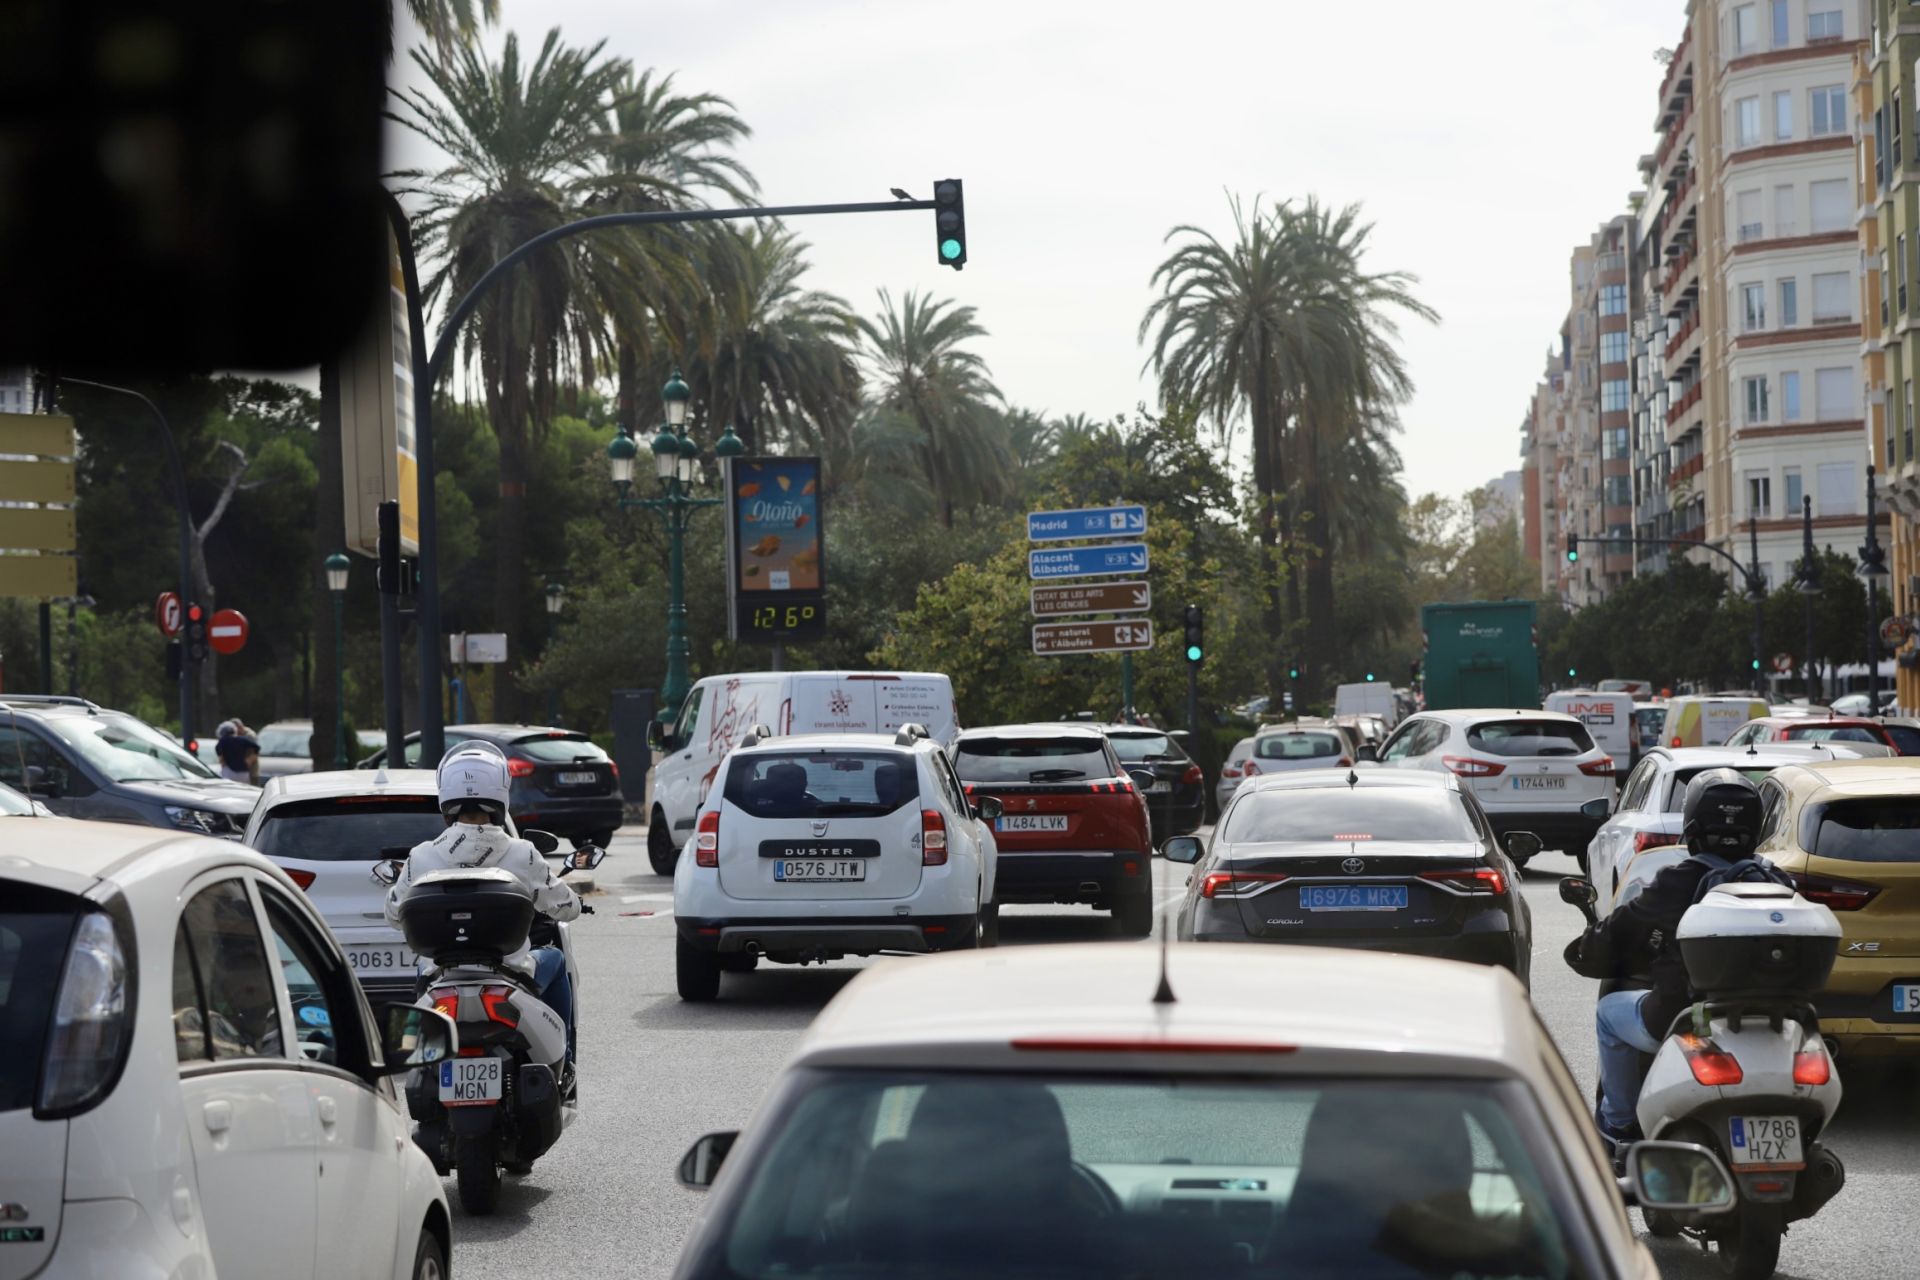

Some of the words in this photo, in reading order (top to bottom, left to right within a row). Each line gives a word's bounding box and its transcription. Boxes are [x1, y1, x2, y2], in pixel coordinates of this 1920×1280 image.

[753, 500, 802, 522] Otoño
[1031, 519, 1068, 531] Madrid
[1032, 553, 1074, 564] Alacant
[1033, 564, 1080, 575] Albacete
[1059, 591, 1069, 600] DE
[1071, 590, 1084, 599] LES
[1086, 589, 1104, 598] ARTS
[1040, 601, 1054, 609] LES
[1035, 630, 1054, 639] parc
[1059, 628, 1091, 637] natural
[1036, 641, 1047, 649] de
[1051, 638, 1093, 648] l'Albufera
[1520, 778, 1544, 788] 1744
[1006, 817, 1036, 829] 1484
[1041, 817, 1064, 829] LVK
[785, 848, 853, 856] DUSTER
[785, 862, 825, 877] 0576
[829, 862, 858, 876] JTW
[1312, 888, 1361, 905] 6976
[1366, 887, 1402, 905] MRX
[1846, 943, 1880, 951] X2
[349, 952, 393, 968] 3063
[459, 1064, 498, 1082] 1028
[454, 1082, 487, 1100] MGN
[1748, 1120, 1796, 1139] 1786
[1748, 1140, 1786, 1160] HZX
